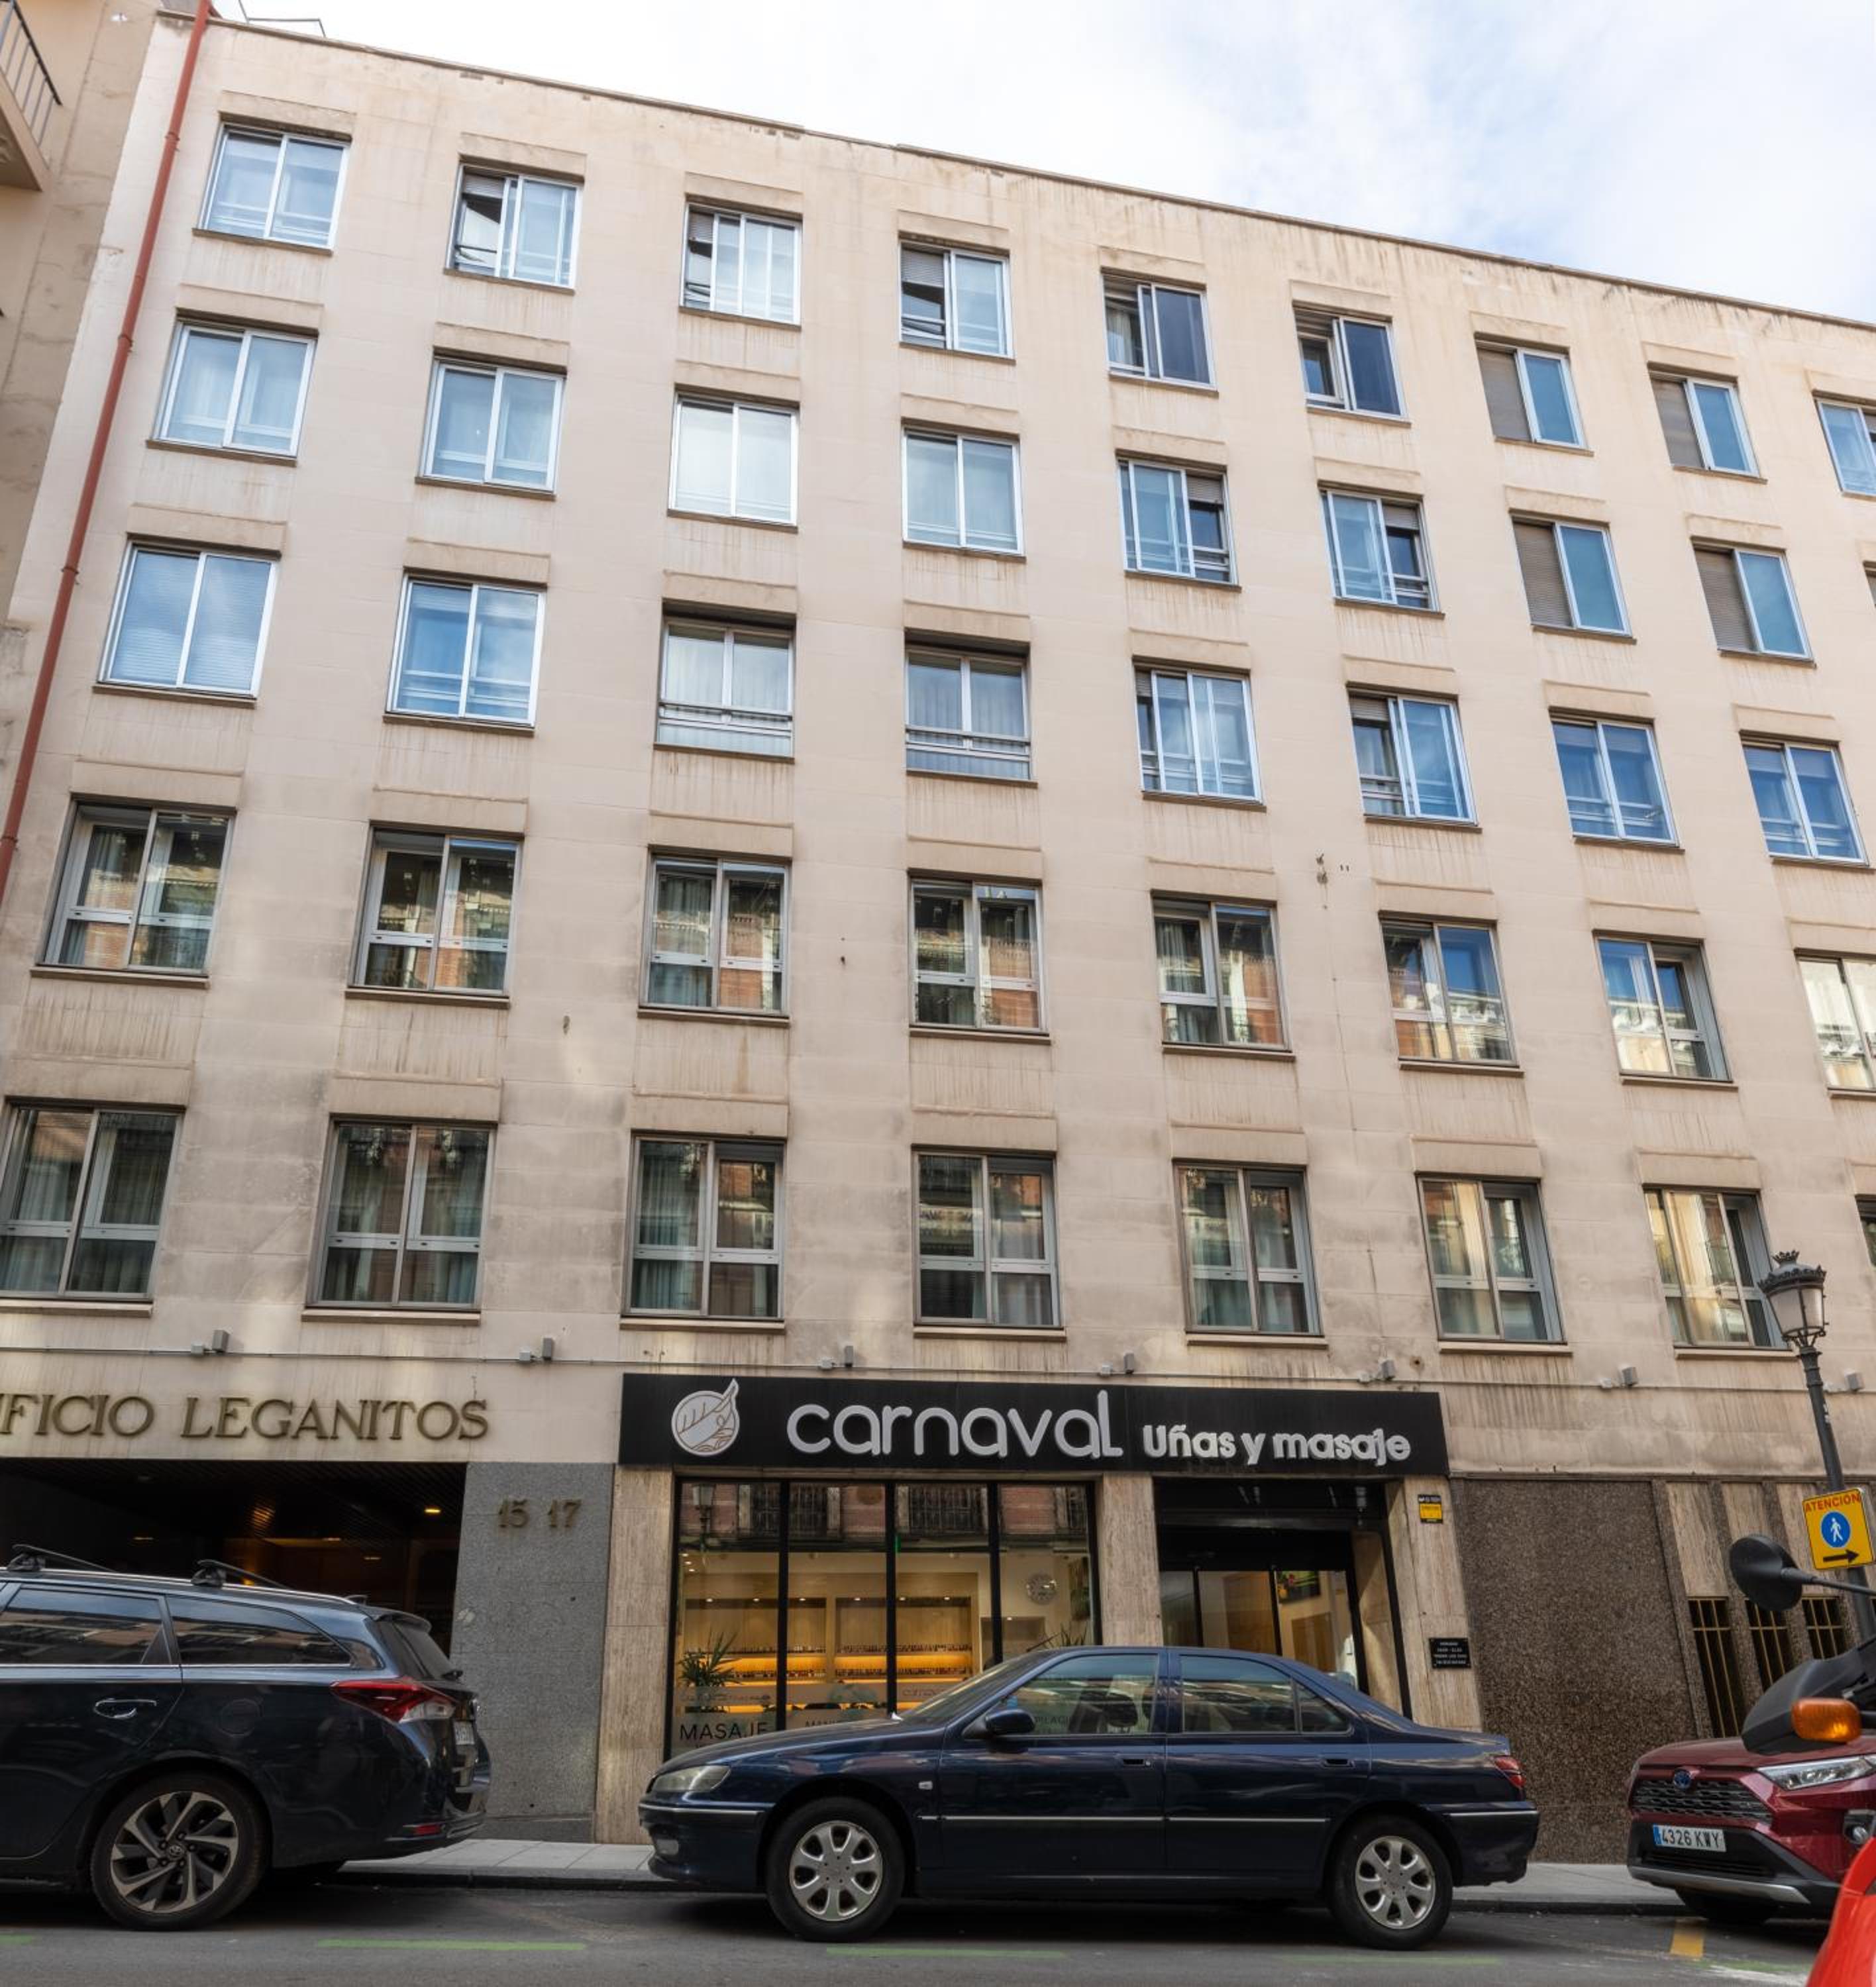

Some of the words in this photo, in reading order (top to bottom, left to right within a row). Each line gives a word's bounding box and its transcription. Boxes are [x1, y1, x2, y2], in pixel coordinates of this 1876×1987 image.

[0, 1393, 154, 1437] FICIO
[180, 1396, 489, 1441] LEGANITOS
[786, 1390, 1123, 1458] carnaval
[1241, 1433, 1266, 1465] y
[1273, 1429, 1411, 1466] masaje
[498, 1500, 531, 1529] 15
[547, 1500, 582, 1528] 17
[1662, 1829, 1693, 1846] 4326
